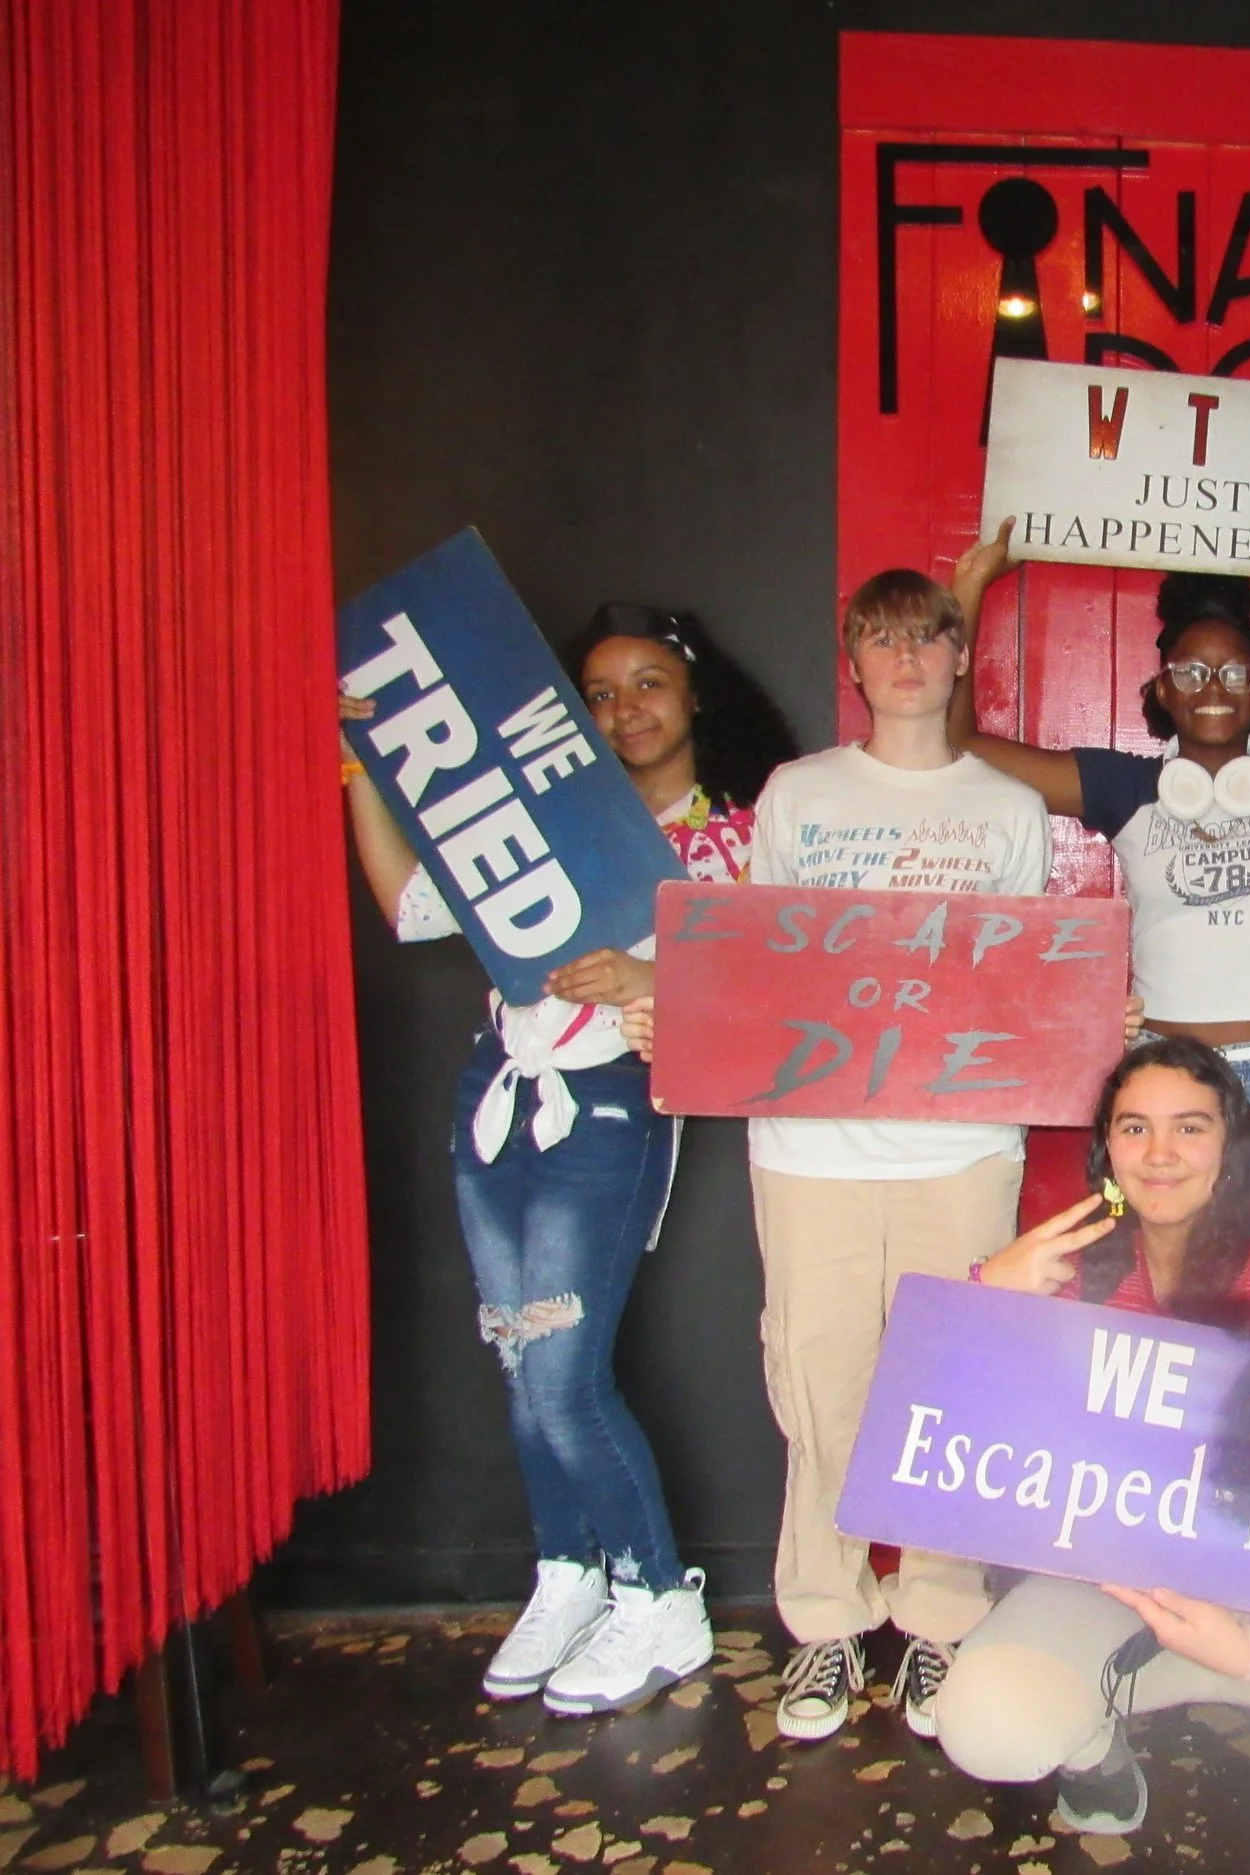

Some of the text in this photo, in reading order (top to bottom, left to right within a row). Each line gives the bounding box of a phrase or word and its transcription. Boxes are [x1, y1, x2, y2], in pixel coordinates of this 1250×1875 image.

[1135, 474, 1250, 512] JUST
[497, 686, 598, 795] WE
[340, 612, 582, 959] TRIED
[852, 851, 895, 866] THE
[892, 848, 991, 873] 2 WHEELS
[889, 873, 948, 888] MOVE
[1203, 865, 1247, 893] 78
[672, 896, 1111, 971] ESCAPE
[1208, 911, 1245, 926] NYC
[848, 976, 932, 1013] OR
[728, 1019, 1027, 1106] DIE
[1086, 1328, 1196, 1430] WE
